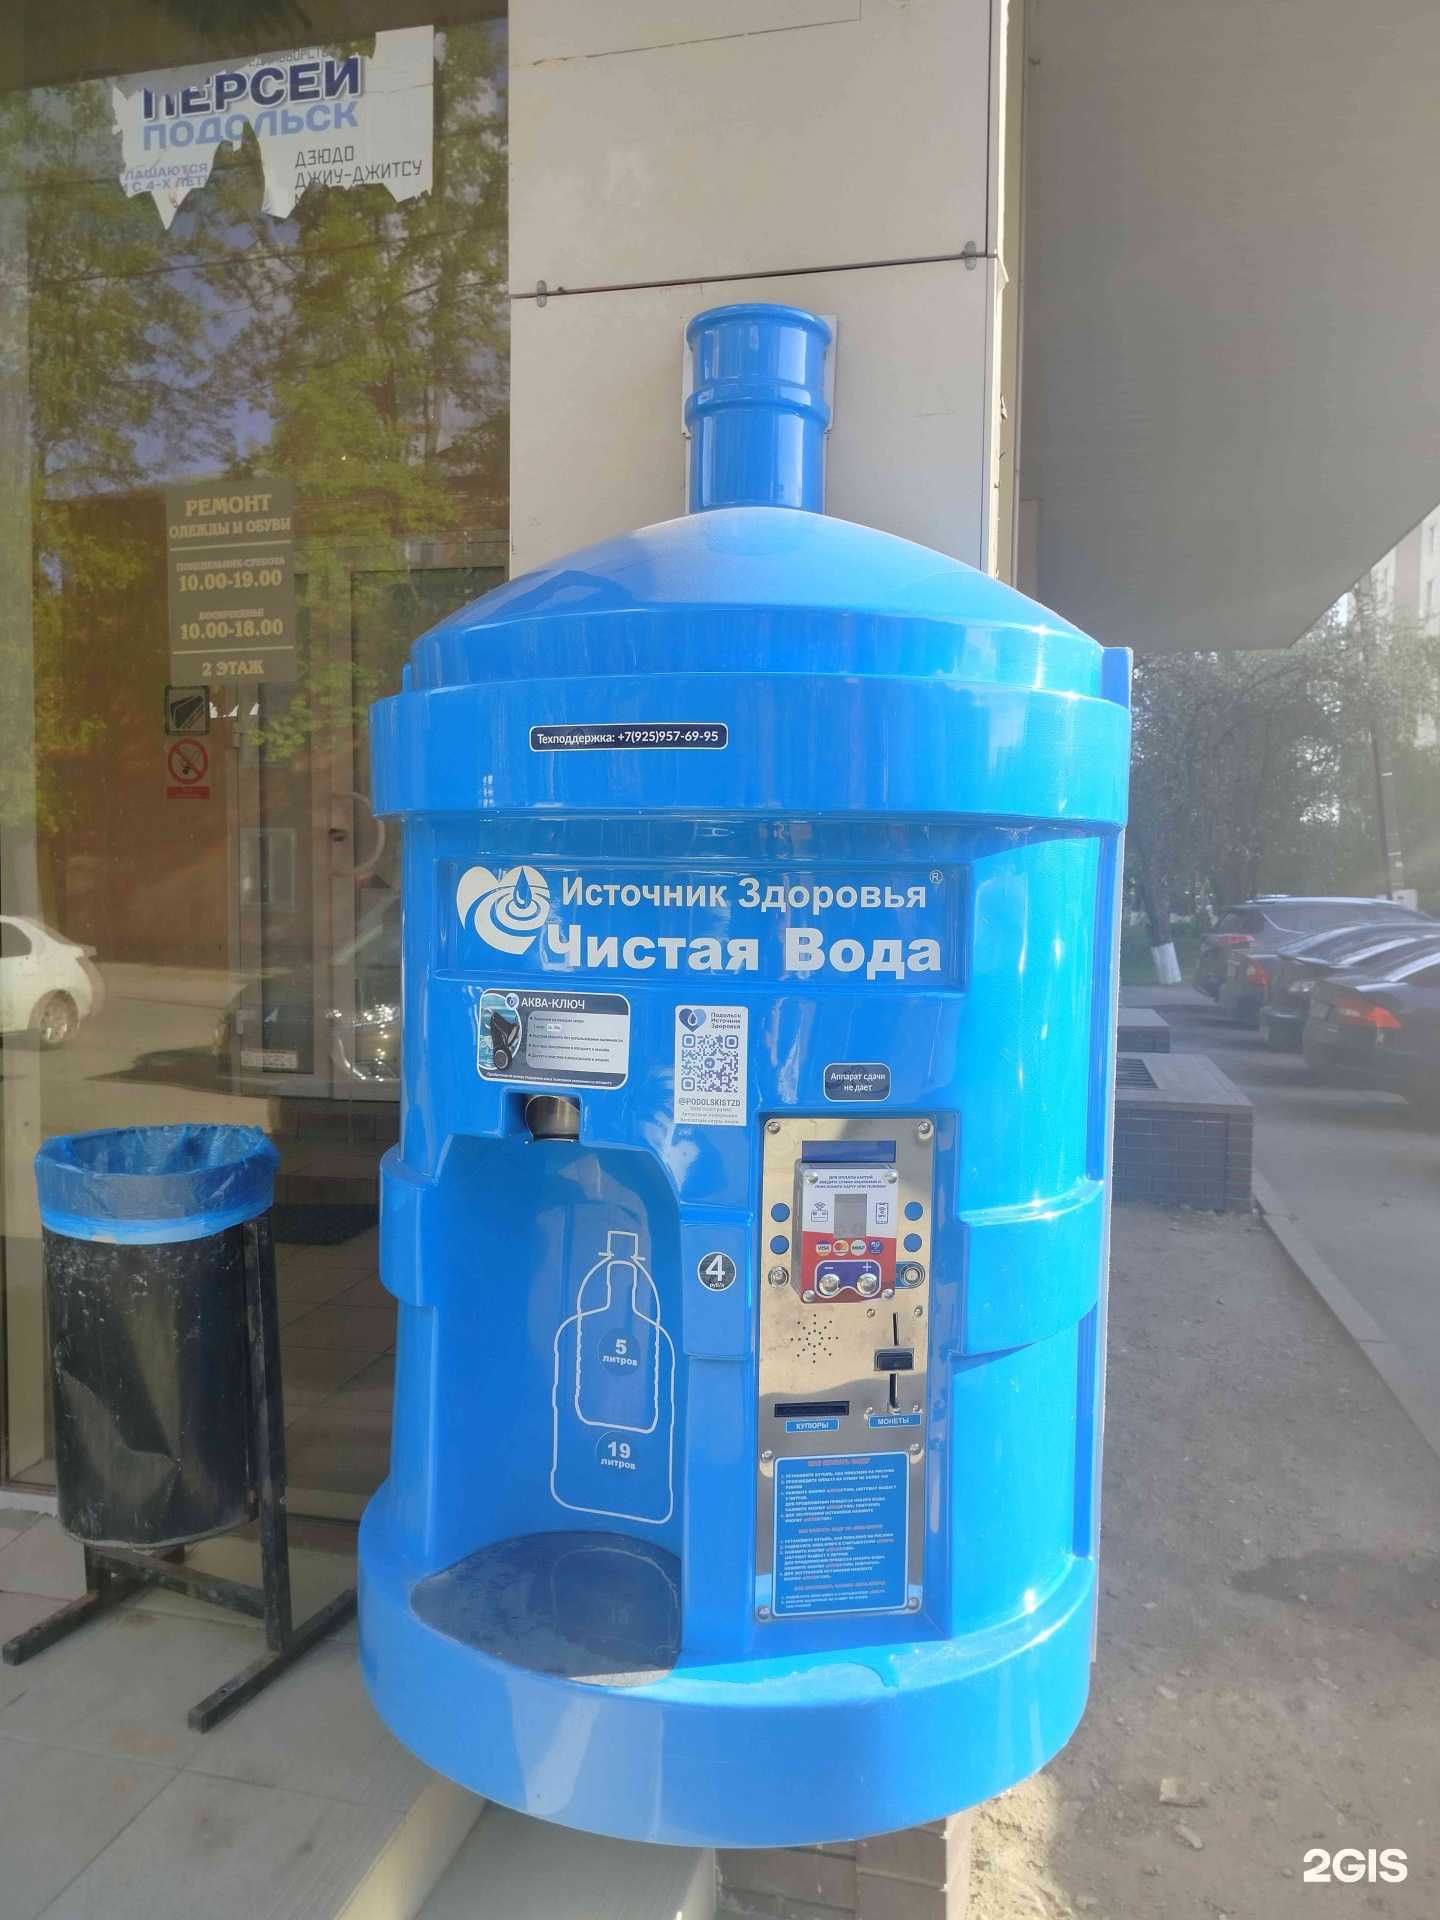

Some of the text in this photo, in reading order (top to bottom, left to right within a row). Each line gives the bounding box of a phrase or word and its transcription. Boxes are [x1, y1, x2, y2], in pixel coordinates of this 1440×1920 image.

[143, 101, 359, 150] ПОДОЛЬСК
[295, 145, 354, 168] ДЗЮДО
[295, 160, 423, 190] ДЖИУ-ДЖИТСУ
[185, 494, 273, 517] РЕМОНТ
[232, 521, 243, 534] И
[246, 517, 291, 532] ОБУВИ
[179, 568, 283, 592] 10.00-19.00
[202, 660, 264, 676] 2 ЭТАЖ
[537, 731, 719, 745] Техподдержка: +7(925)957-69-95
[562, 876, 727, 907] Источник
[738, 877, 926, 915] Здоровья
[548, 923, 942, 980] Чистая Вода
[521, 998, 585, 1010] АКВА-КЛЮЧ
[831, 1072, 886, 1081] Аппарат сдачи
[855, 1084, 873, 1092] дает
[706, 1254, 726, 1281] 4
[615, 1339, 627, 1355] 5
[603, 1355, 638, 1367] литров
[796, 1422, 829, 1430] КУПЮРЫ
[877, 1416, 909, 1425] МОНЕТЫ
[607, 1441, 631, 1459] 19
[601, 1457, 636, 1470] литров
